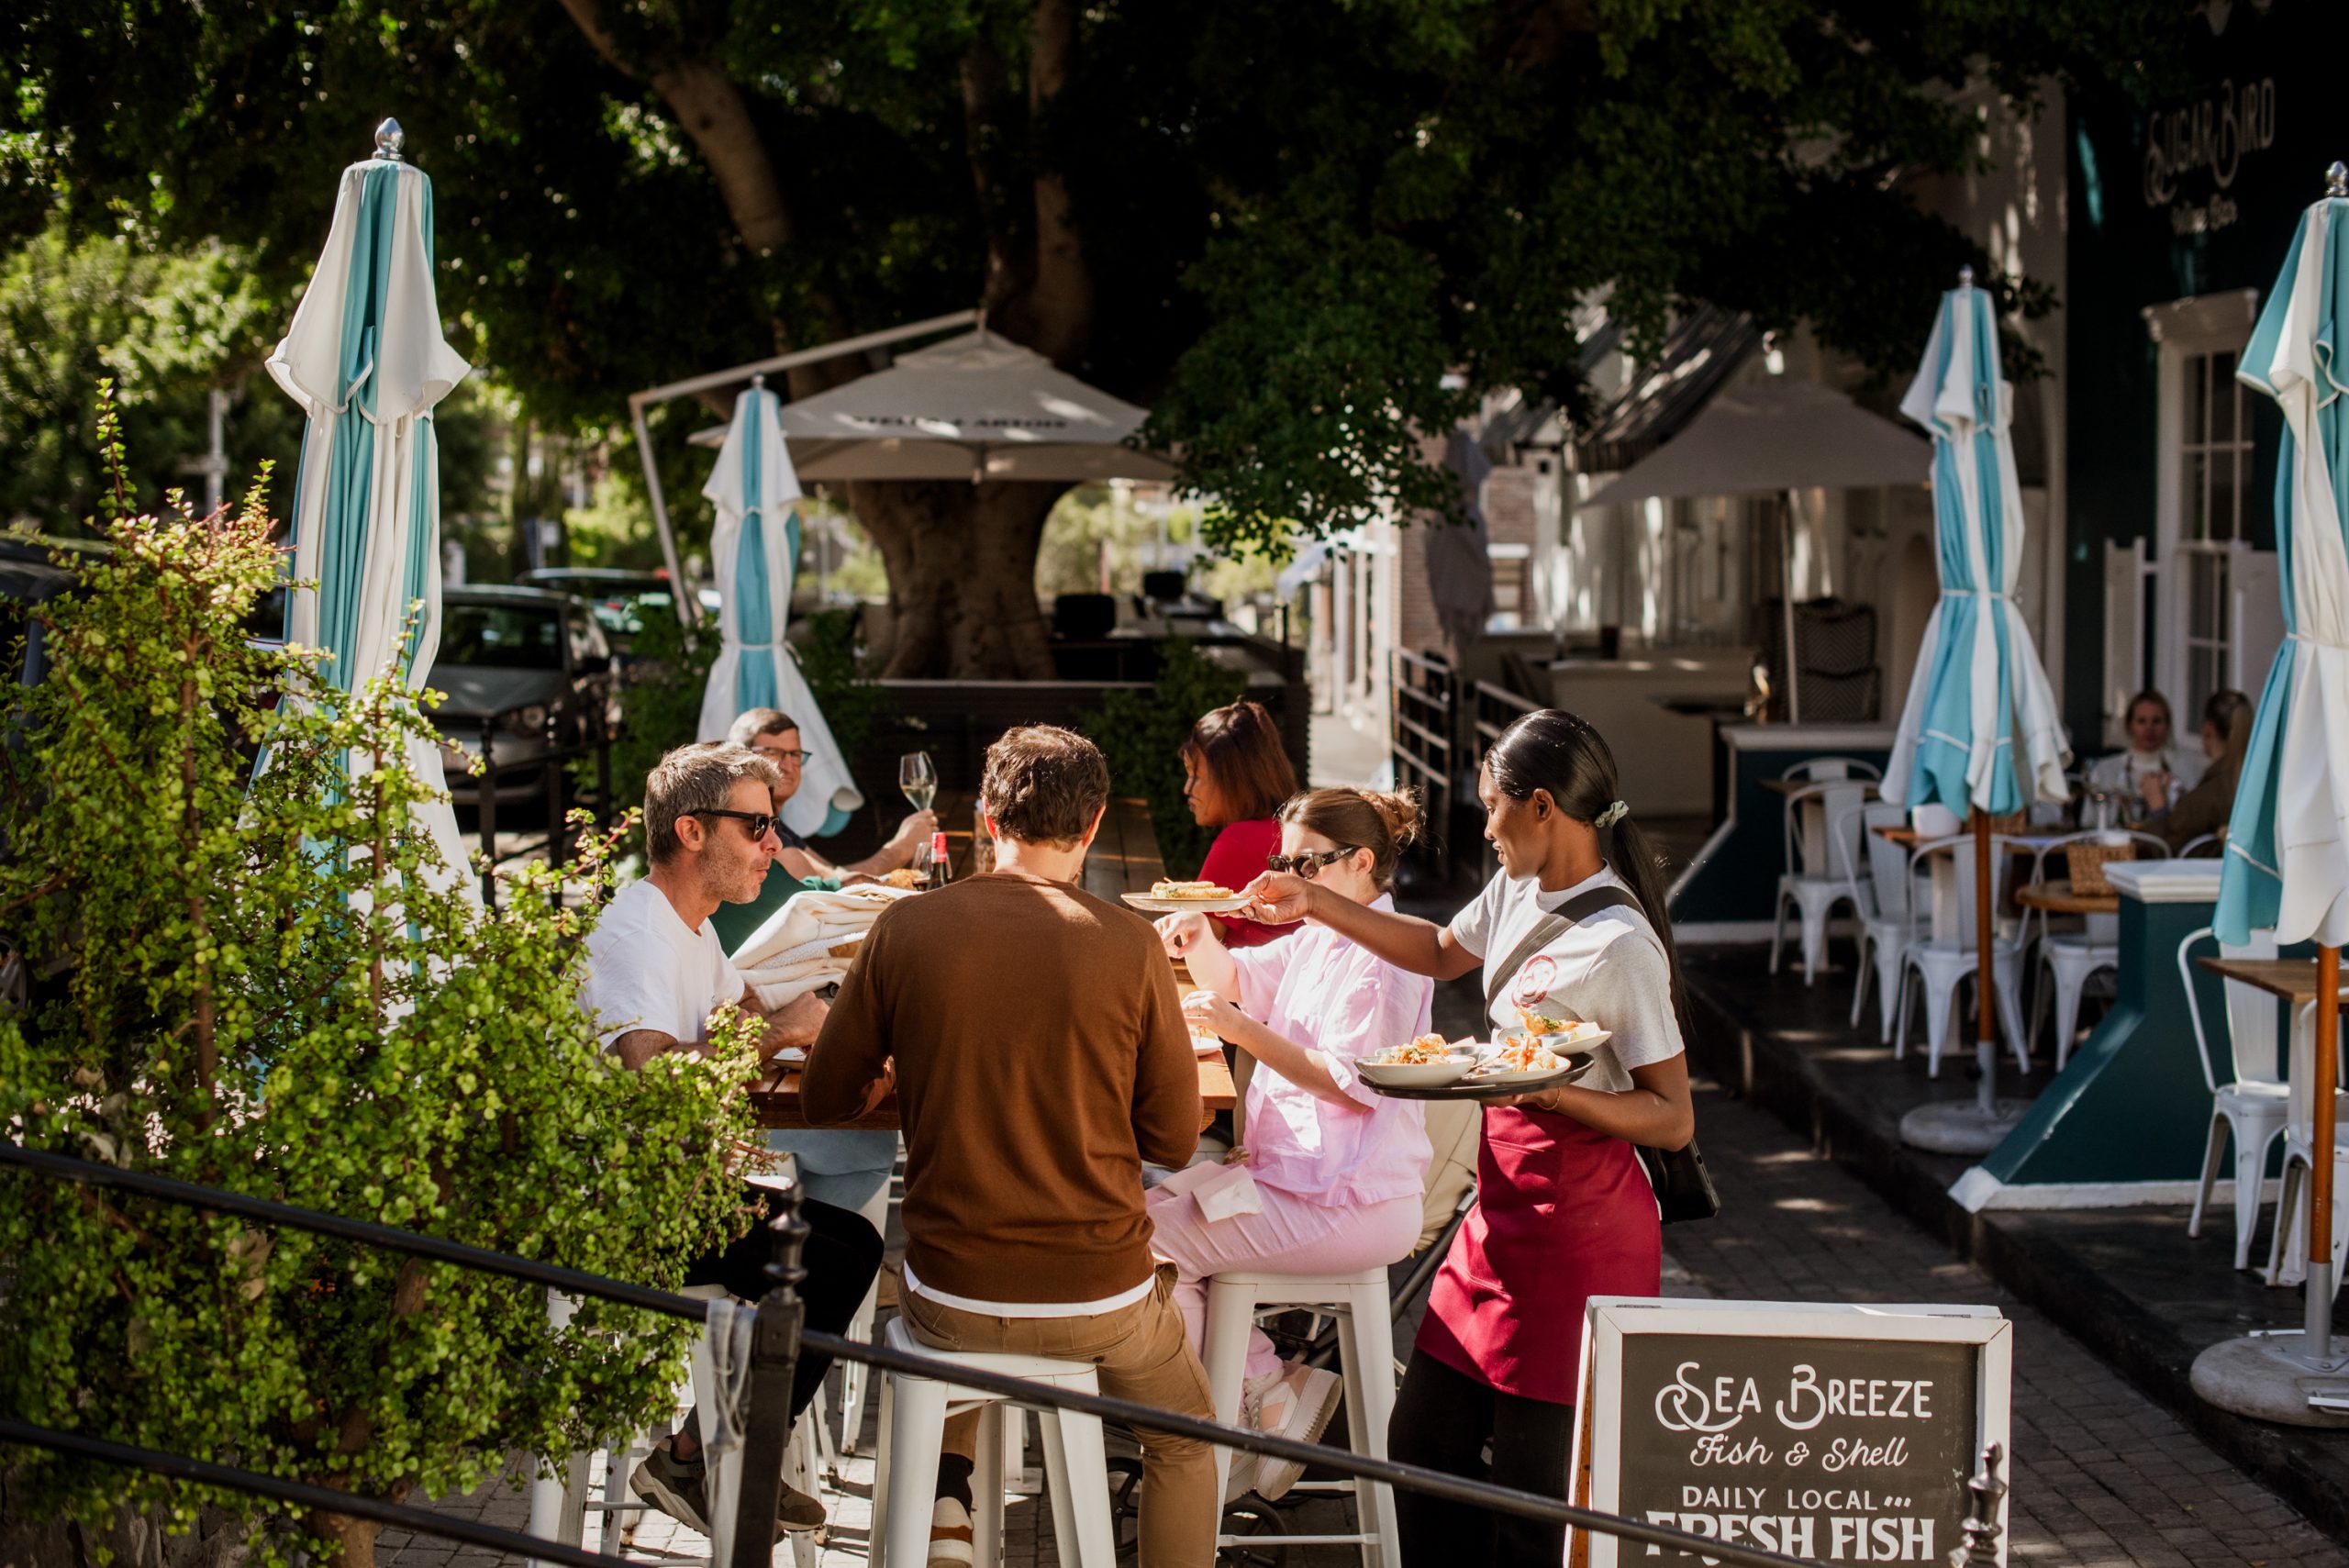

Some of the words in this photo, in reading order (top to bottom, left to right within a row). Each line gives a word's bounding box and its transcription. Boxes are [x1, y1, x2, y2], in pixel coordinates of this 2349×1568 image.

[2143, 98, 2214, 208] SUGAR
[2212, 76, 2276, 189] BIRD
[1654, 1362, 1763, 1432] SEA
[1775, 1363, 1934, 1430] BREEZE
[1689, 1433, 1774, 1467] Fish
[1785, 1440, 1810, 1467] &
[1821, 1436, 1909, 1473] Shell
[1682, 1485, 1767, 1509] DAILY
[1830, 1517, 1935, 1562] FISH
